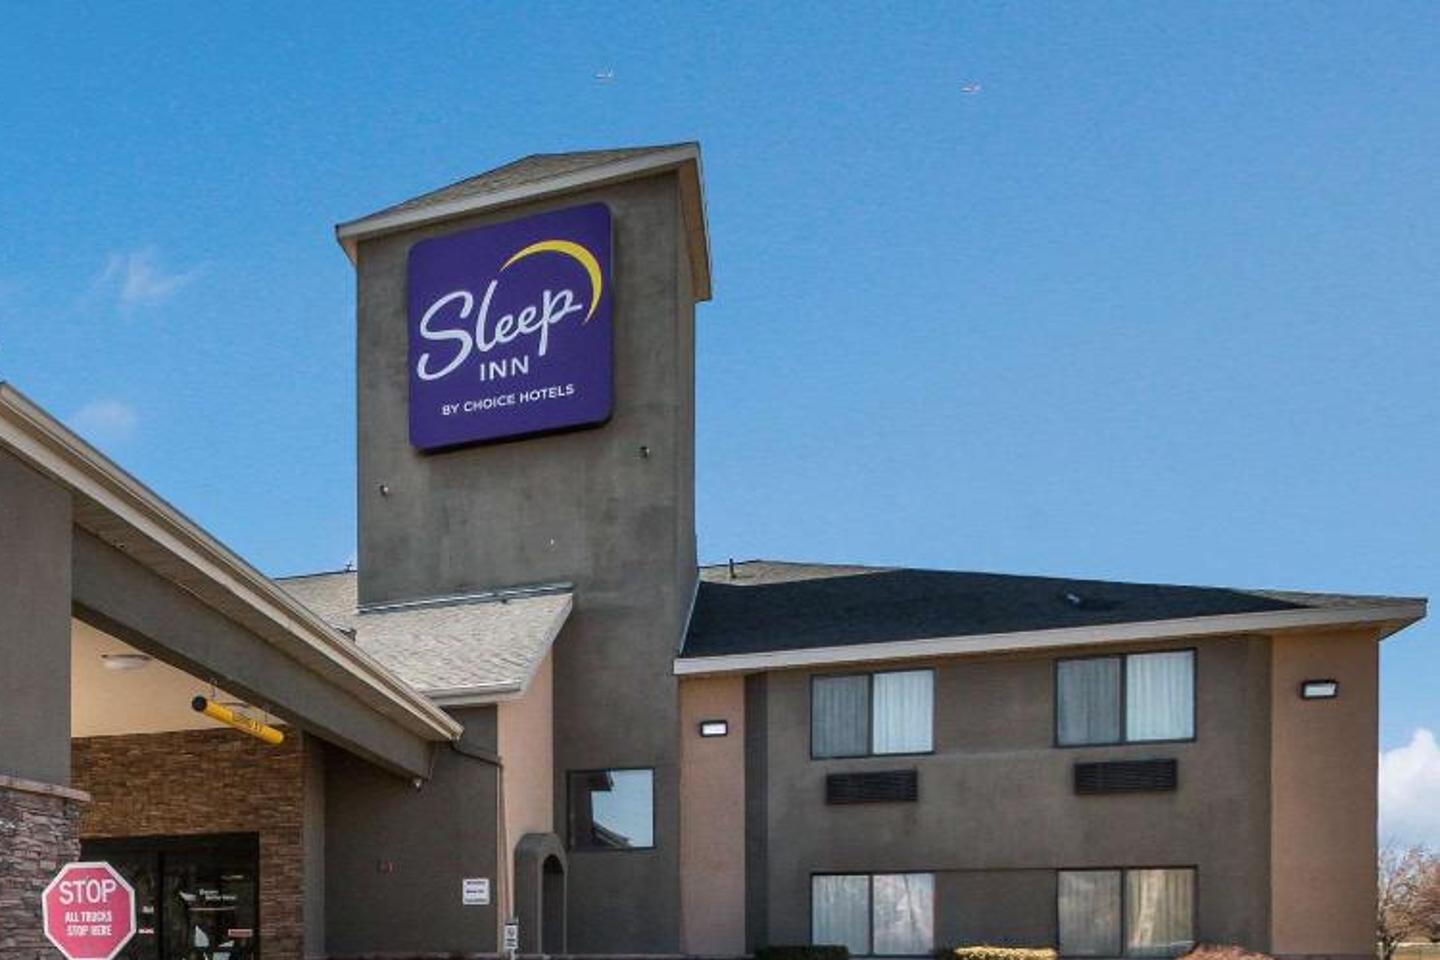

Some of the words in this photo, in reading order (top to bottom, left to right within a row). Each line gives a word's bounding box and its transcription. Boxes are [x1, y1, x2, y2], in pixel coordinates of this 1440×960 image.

[417, 280, 582, 381] Sleep
[480, 356, 529, 381] INN
[442, 404, 460, 416] BY
[464, 395, 516, 412] CHOICE
[519, 383, 574, 403] HOTELS
[59, 879, 116, 905] STOP
[64, 911, 79, 922] ALL
[66, 924, 89, 936] STOP
[91, 924, 112, 936] HERE
